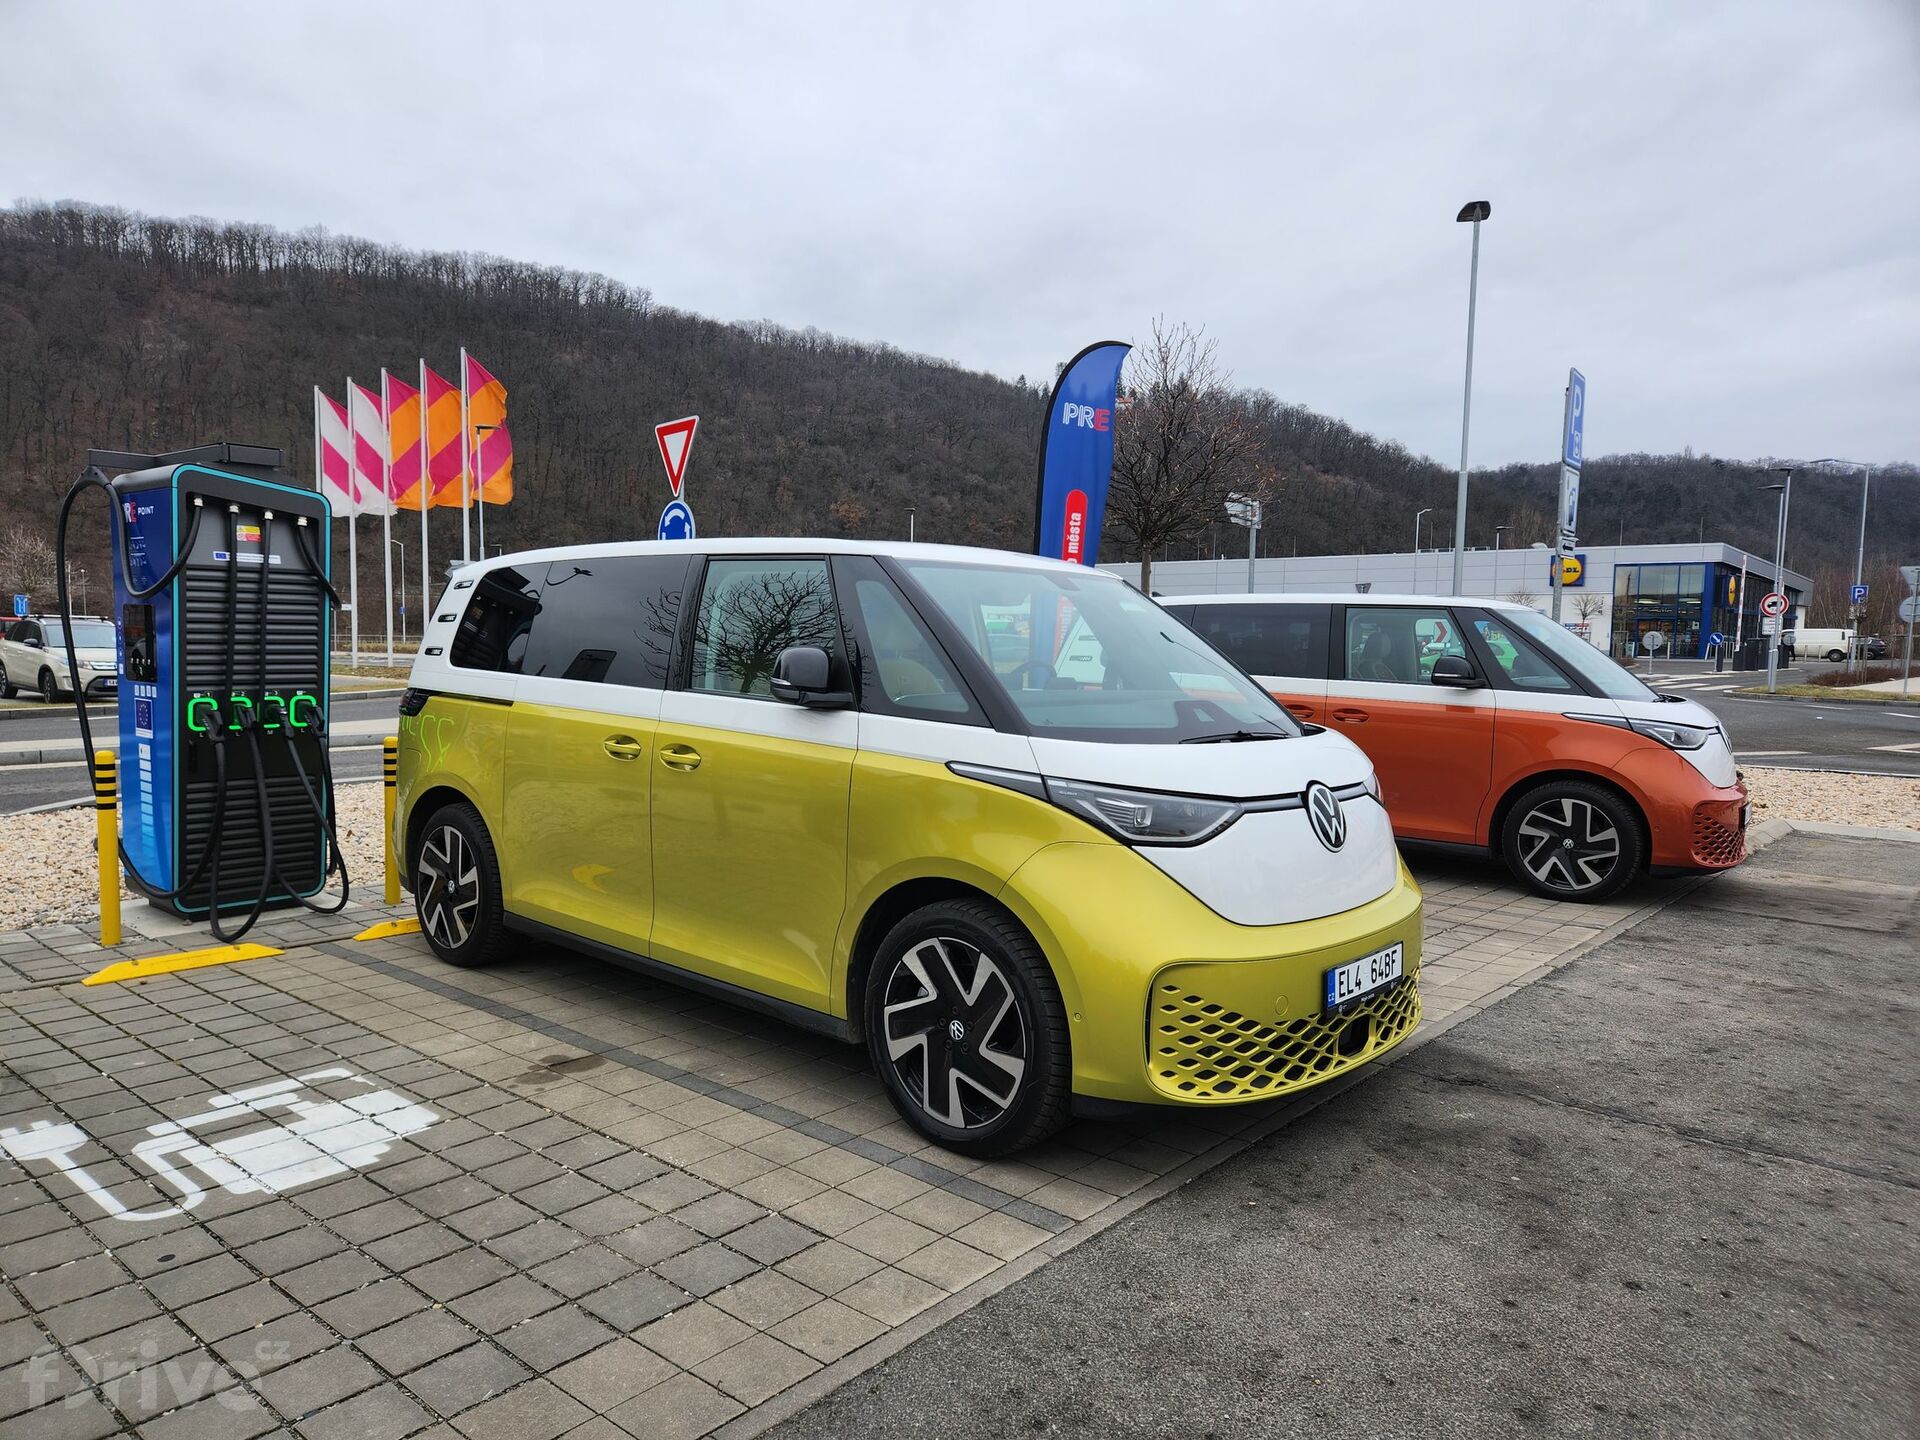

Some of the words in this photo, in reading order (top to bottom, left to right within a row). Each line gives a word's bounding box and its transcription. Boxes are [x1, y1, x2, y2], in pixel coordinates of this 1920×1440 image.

[1063, 402, 1110, 432] PRE
[1571, 384, 1582, 434] P
[137, 505, 155, 516] POINT
[1066, 512, 1082, 554] města
[1854, 588, 1865, 600] P
[1338, 964, 1362, 998] EL4
[1370, 950, 1398, 984] 64BF
